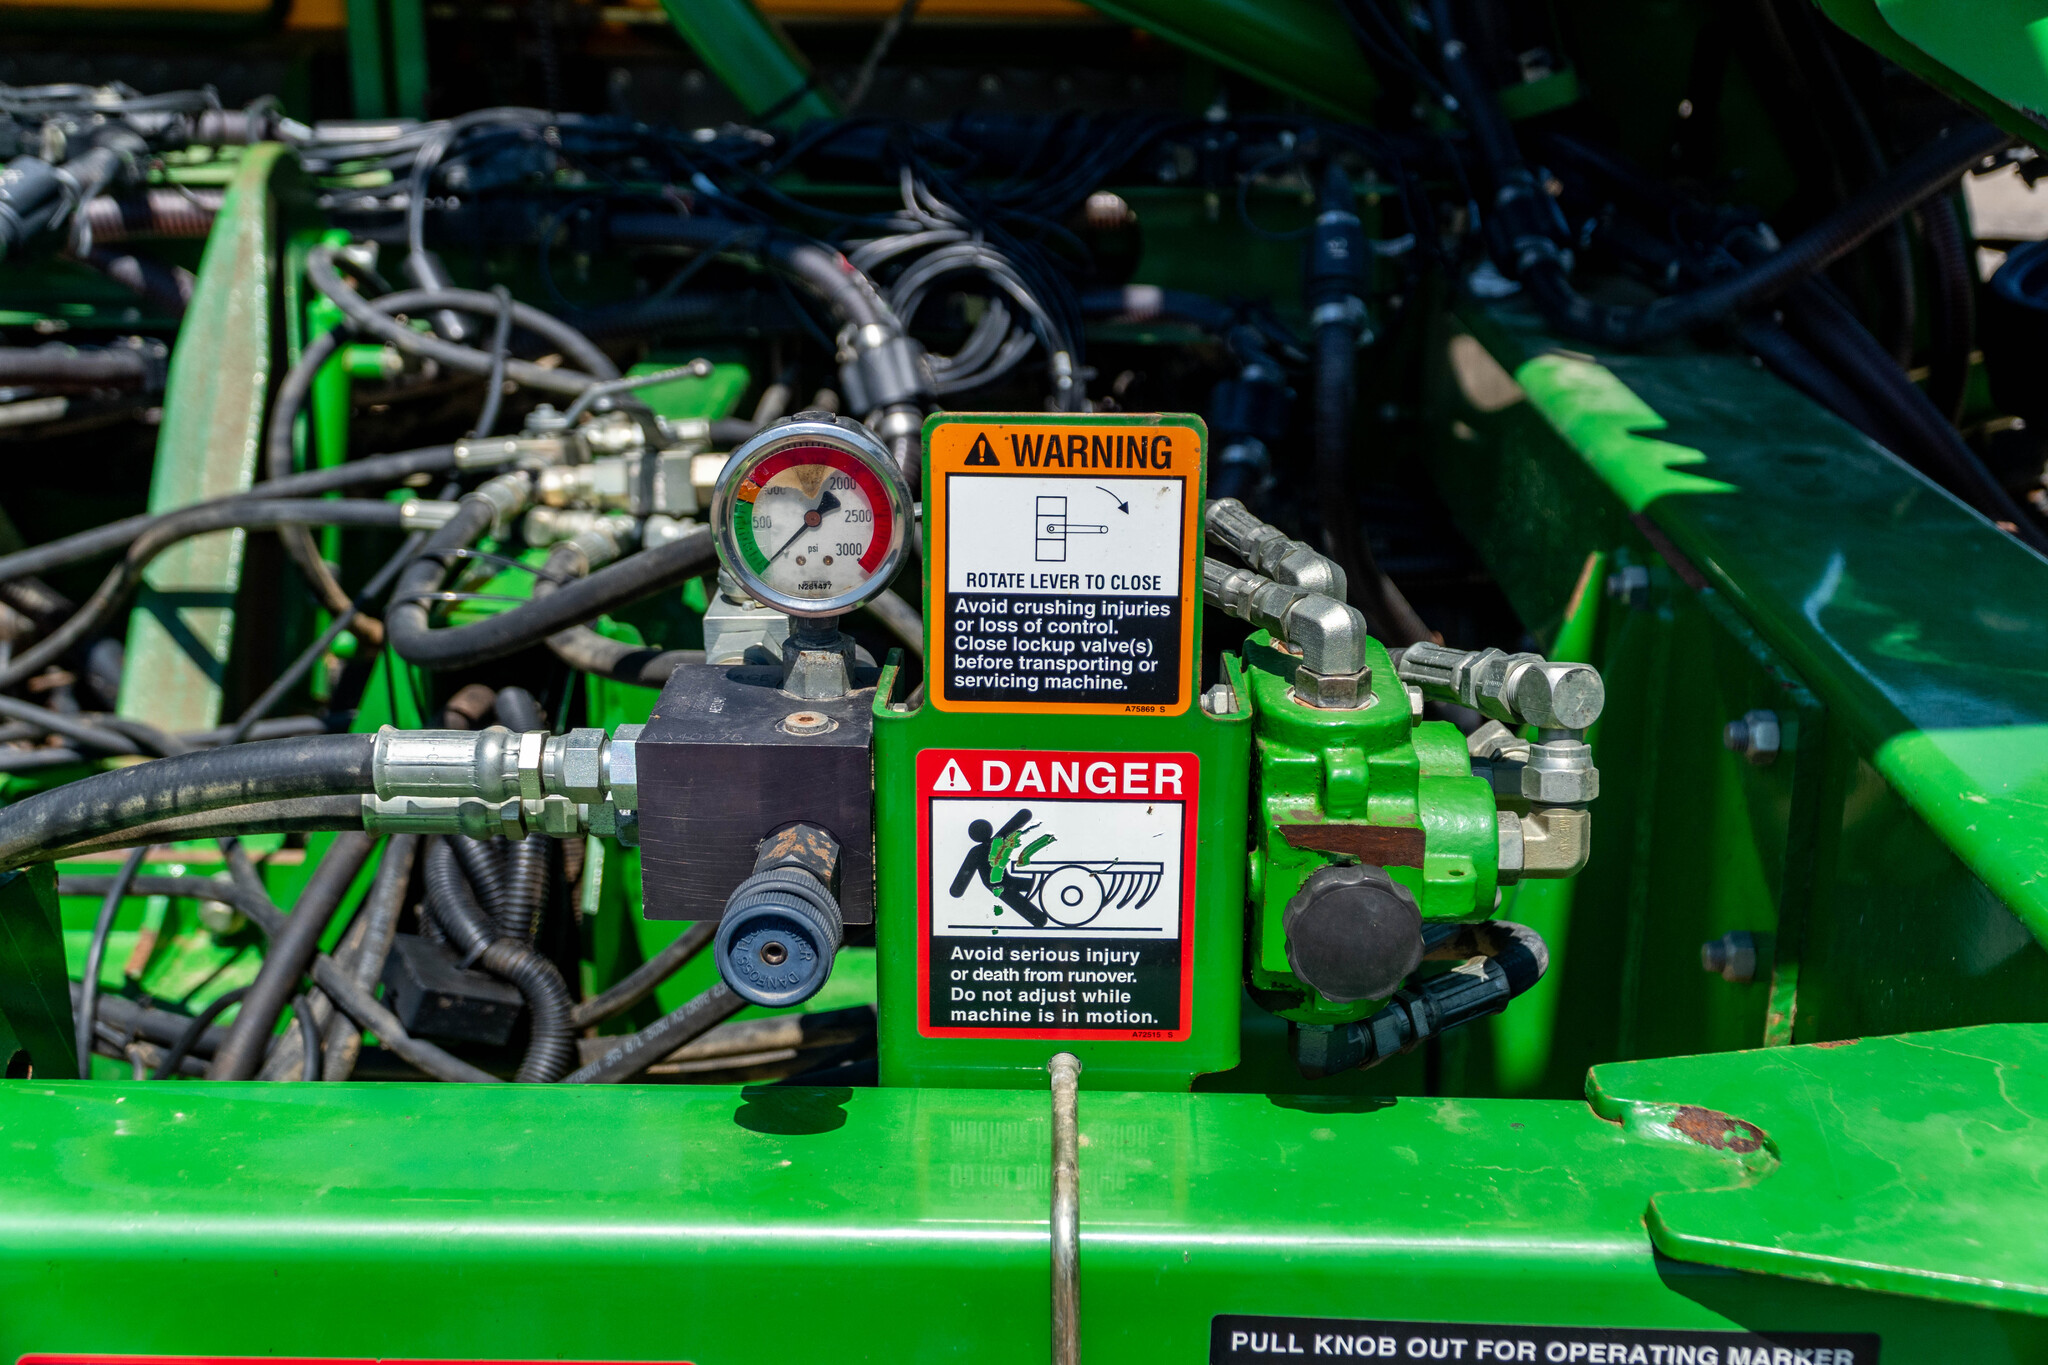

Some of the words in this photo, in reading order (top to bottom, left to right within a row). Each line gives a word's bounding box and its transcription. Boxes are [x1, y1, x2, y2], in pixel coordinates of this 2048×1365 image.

[1010, 433, 1172, 469] WARNING
[829, 476, 857, 491] 2000
[752, 515, 772, 529] 500
[844, 509, 873, 523] 2500
[807, 544, 819, 554] psi
[835, 543, 863, 557] 3000
[966, 572, 1025, 589] ROTATE
[1030, 573, 1080, 590] LEVER
[1085, 574, 1106, 590] TO
[1111, 575, 1161, 591] CLOSE
[954, 598, 1008, 614] Avoid
[1013, 599, 1096, 618] crushing
[1101, 600, 1171, 618] injuries
[954, 619, 975, 632] or
[980, 617, 1018, 633] loss
[1023, 617, 1043, 633] of
[1047, 618, 1119, 635] control.
[954, 635, 1008, 651] Close
[1013, 636, 1075, 655] lockup
[1081, 637, 1154, 657] valve(s)
[954, 654, 1014, 670] before
[1019, 656, 1133, 675] transporting
[1138, 660, 1158, 672] or
[954, 673, 1039, 691] servicing
[1045, 674, 1128, 691] machine.
[1125, 705, 1155, 713] A75869
[1159, 705, 1166, 713] S
[982, 760, 1184, 794] DANGER
[950, 946, 1004, 962] Avoid
[1010, 947, 1080, 962] serious
[1086, 947, 1140, 966] injury
[736, 955, 801, 991] DANFOSS
[950, 969, 969, 981] or
[973, 967, 1019, 982] death
[1024, 968, 1064, 983] from
[1068, 970, 1137, 983] runover.
[951, 987, 976, 1001] Do
[982, 988, 1012, 1002] not
[1018, 989, 1076, 1006] adjust
[1082, 989, 1131, 1003] while
[950, 1008, 1031, 1023] machine
[1038, 1009, 1055, 1023] is
[1062, 1009, 1079, 1023] in
[1086, 1010, 1159, 1024] motion.
[1132, 1031, 1161, 1039] A72515
[1167, 1031, 1174, 1039] S
[1231, 1331, 1304, 1354] PULL
[1314, 1333, 1397, 1356] KNOB
[1406, 1337, 1468, 1358] OUT
[1475, 1339, 1537, 1361] FOR
[1545, 1341, 1719, 1365] OPERATING
[1727, 1346, 1855, 1365] MARKER
